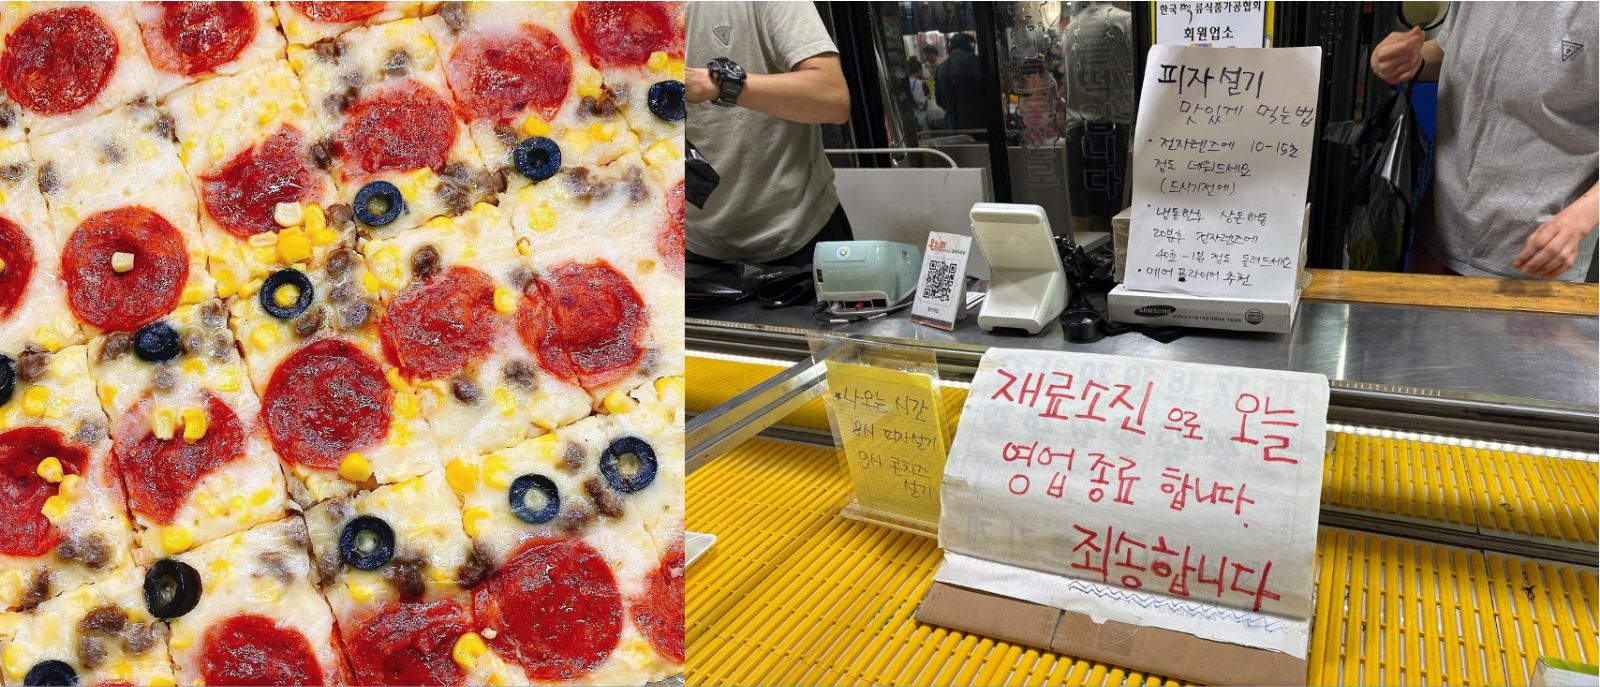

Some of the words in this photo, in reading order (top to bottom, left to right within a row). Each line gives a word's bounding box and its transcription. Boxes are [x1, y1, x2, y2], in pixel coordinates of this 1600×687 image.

[1184, 26, 1234, 41] 회원업소
[1179, 101, 1243, 125] 맛있게
[1154, 159, 1176, 173] 정도
[1211, 252, 1231, 265] 정도
[1223, 271, 1252, 286] 추천
[1139, 306, 1172, 316] SAMSUNG
[844, 387, 889, 413] 나오는
[895, 395, 930, 422] 시간
[991, 368, 1154, 436] 재료소진
[1163, 407, 1204, 440] 으로
[1230, 393, 1299, 464] 오늘
[1002, 440, 1077, 499] 영업
[1088, 452, 1141, 506] 종료
[904, 478, 932, 500] 설기
[1070, 523, 1281, 612] 죄송합니다
